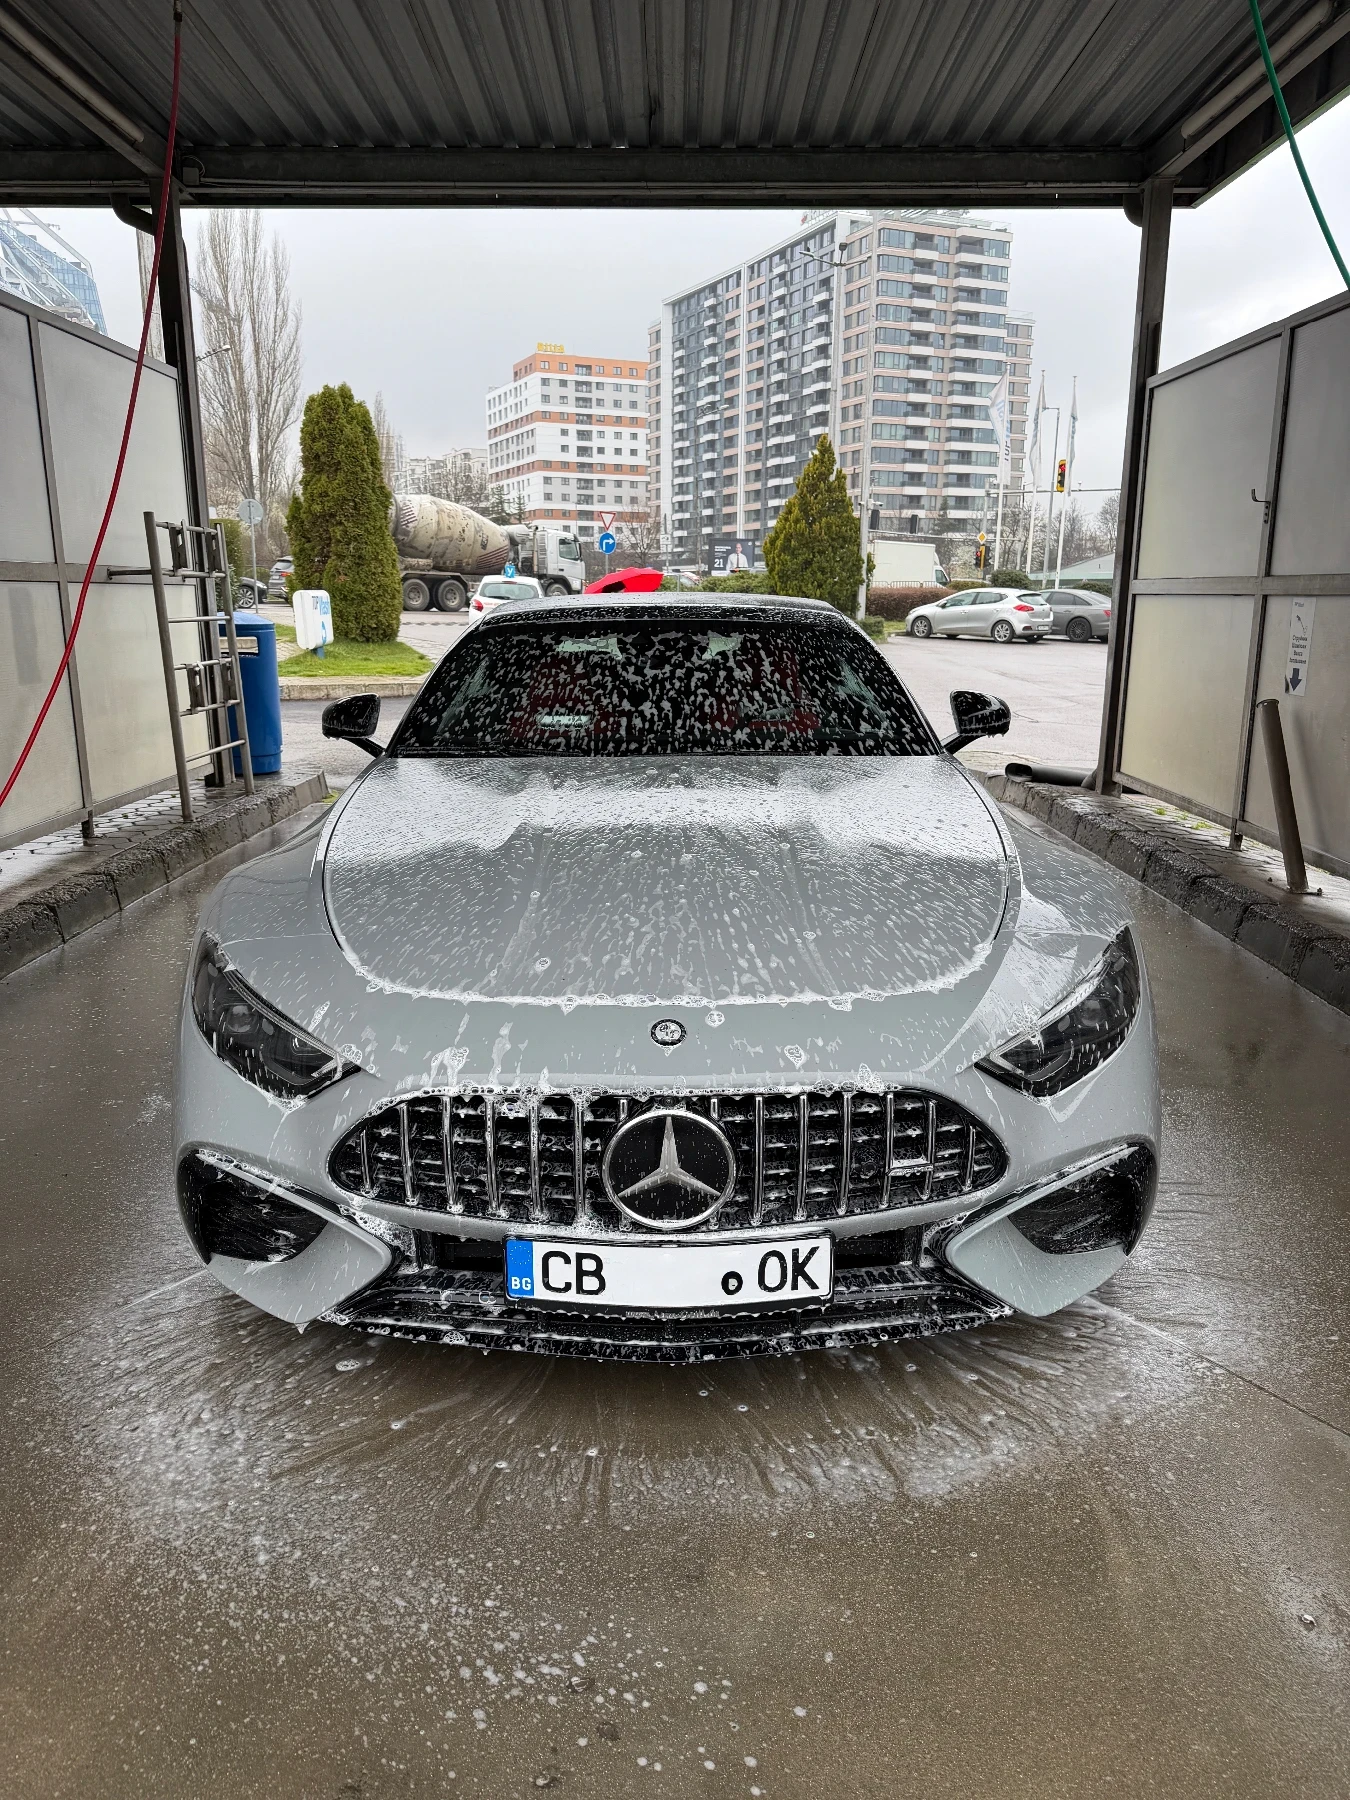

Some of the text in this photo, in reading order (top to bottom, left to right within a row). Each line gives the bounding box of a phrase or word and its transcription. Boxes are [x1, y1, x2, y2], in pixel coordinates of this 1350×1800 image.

[714, 558, 724, 568] 21
[541, 1250, 606, 1295] CB
[757, 1246, 820, 1293] OK
[511, 1276, 532, 1291] BG
